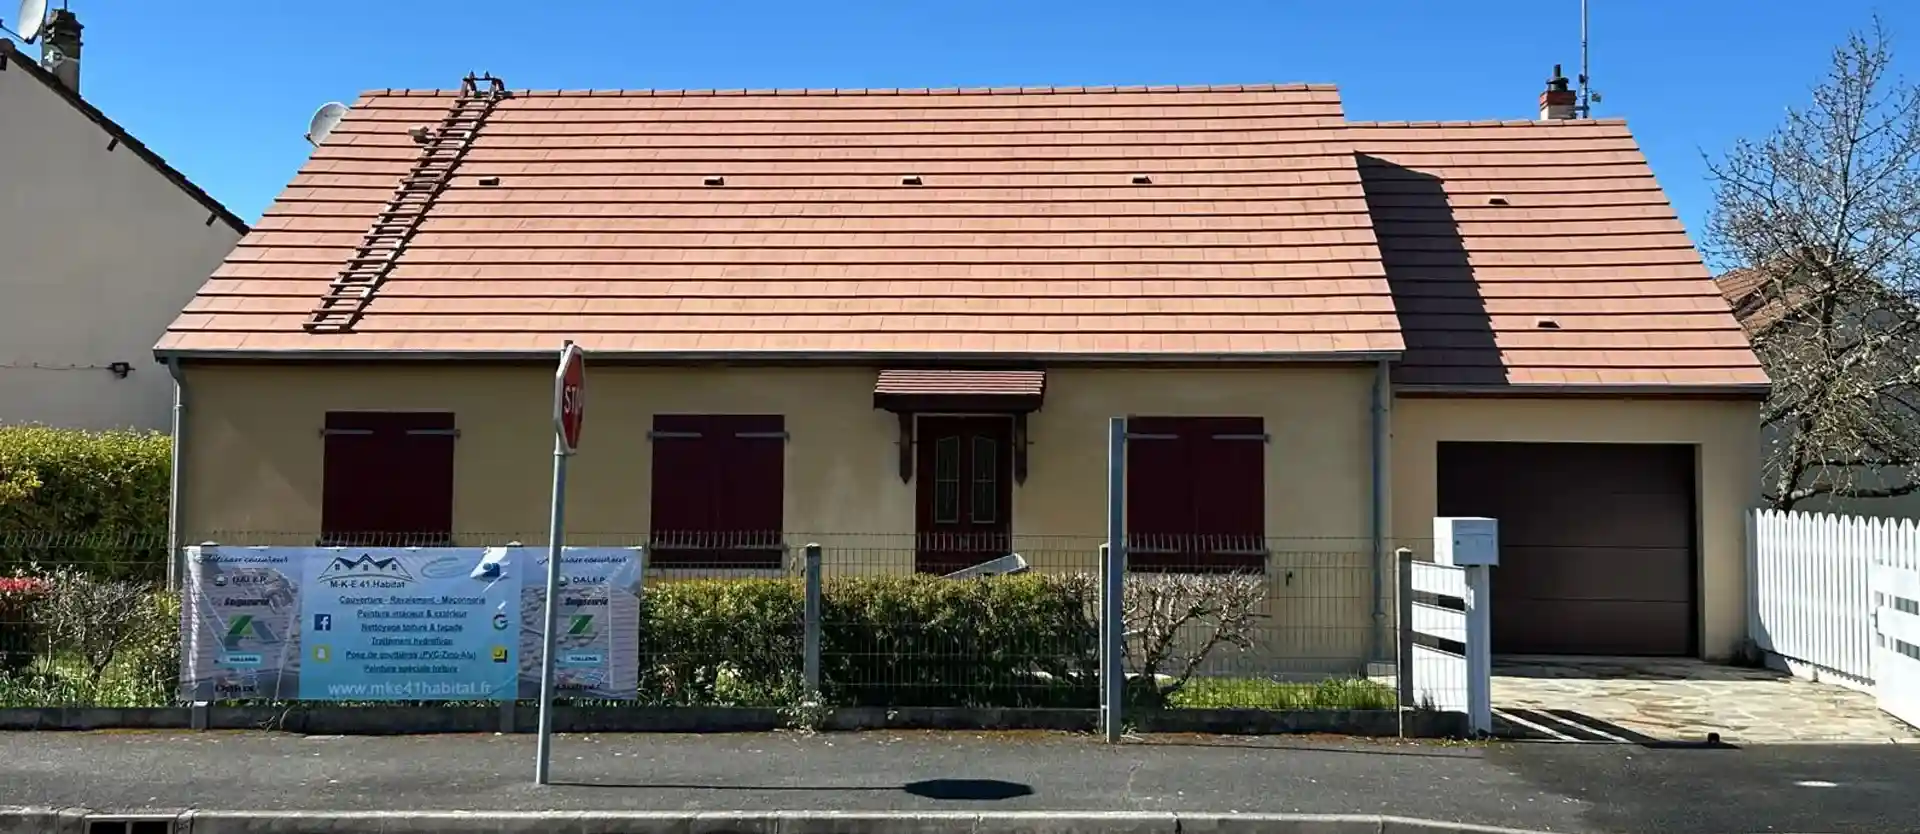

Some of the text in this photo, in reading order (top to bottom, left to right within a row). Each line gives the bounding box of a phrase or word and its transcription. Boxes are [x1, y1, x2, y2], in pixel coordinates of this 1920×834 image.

[330, 579, 357, 588] M-K-E
[340, 596, 382, 605] Couverture
[357, 609, 390, 618] Peinture
[327, 680, 493, 697] www.mke41habitat.fr
